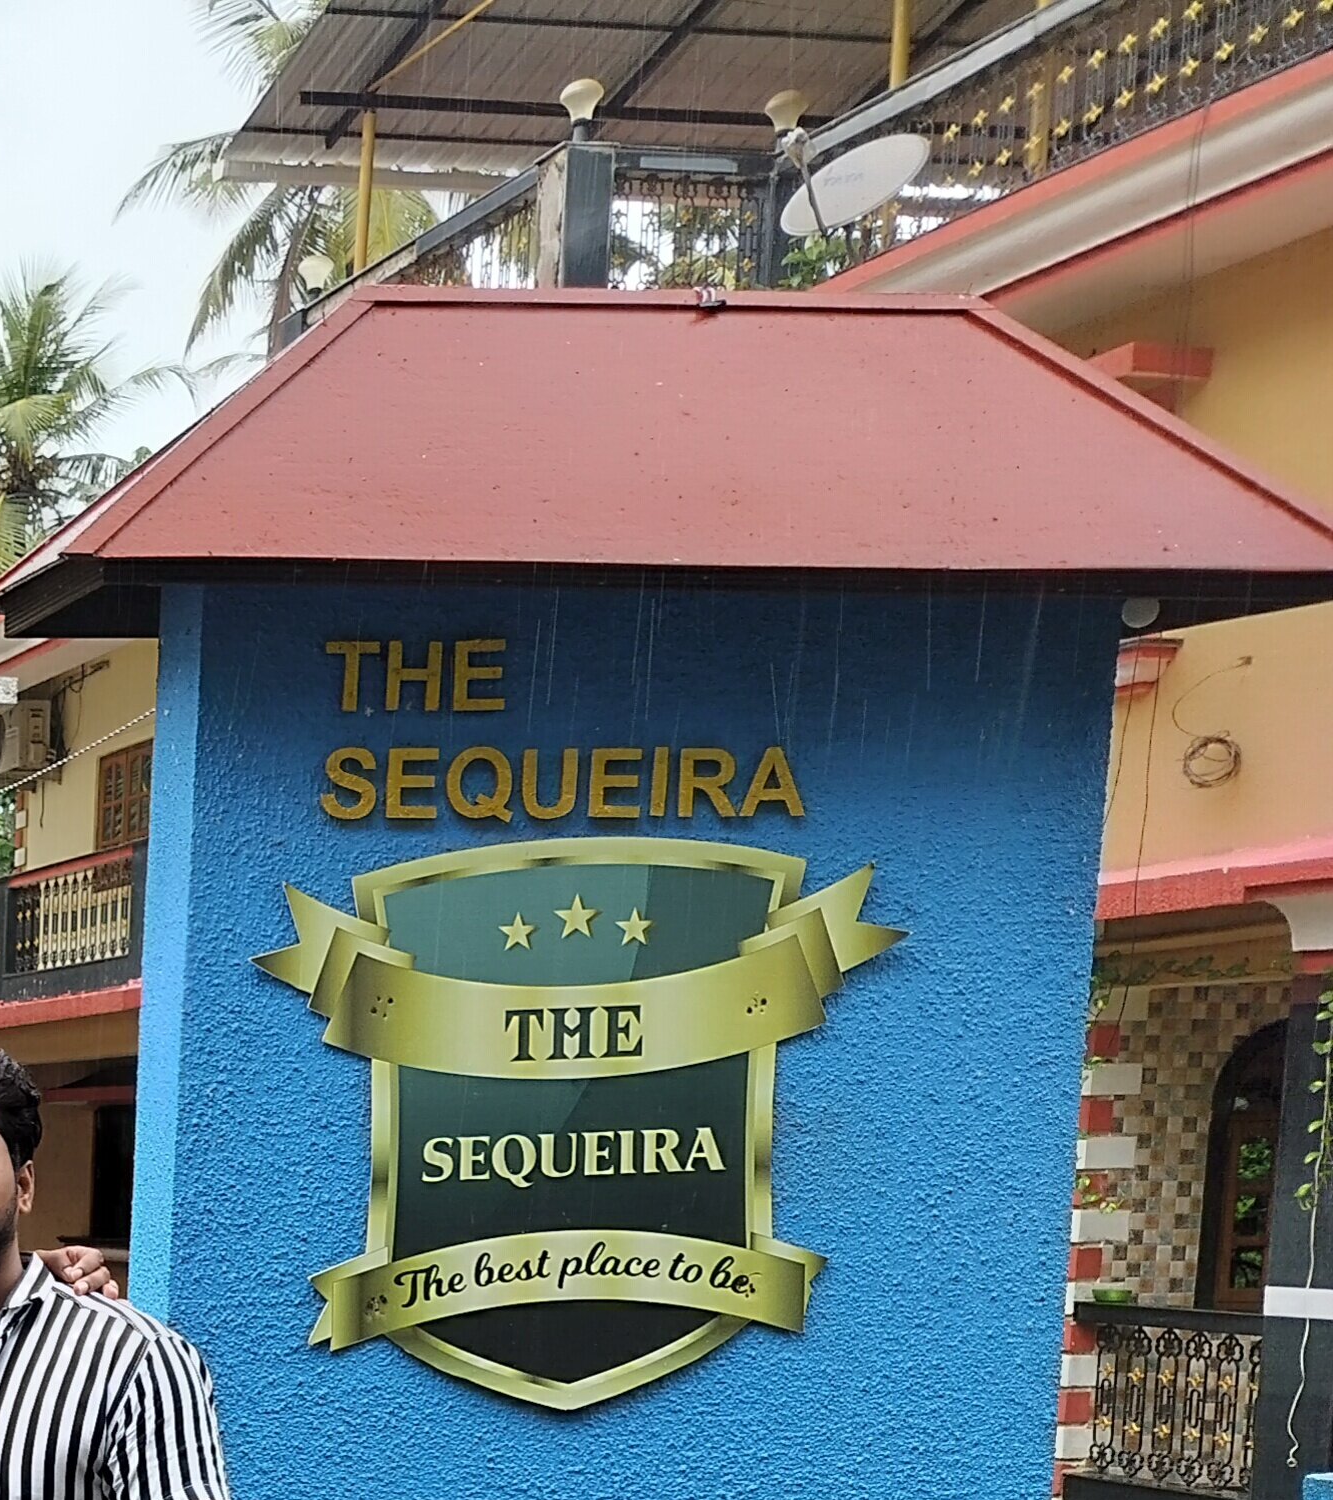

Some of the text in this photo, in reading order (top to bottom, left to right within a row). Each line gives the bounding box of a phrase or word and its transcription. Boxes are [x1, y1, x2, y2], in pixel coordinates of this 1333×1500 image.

[324, 637, 507, 713] THE
[320, 745, 807, 823] SEQUEIRA
[504, 1004, 645, 1063] THE
[420, 1126, 727, 1188] SEQUEIRA
[393, 1240, 749, 1309] The best place to be
